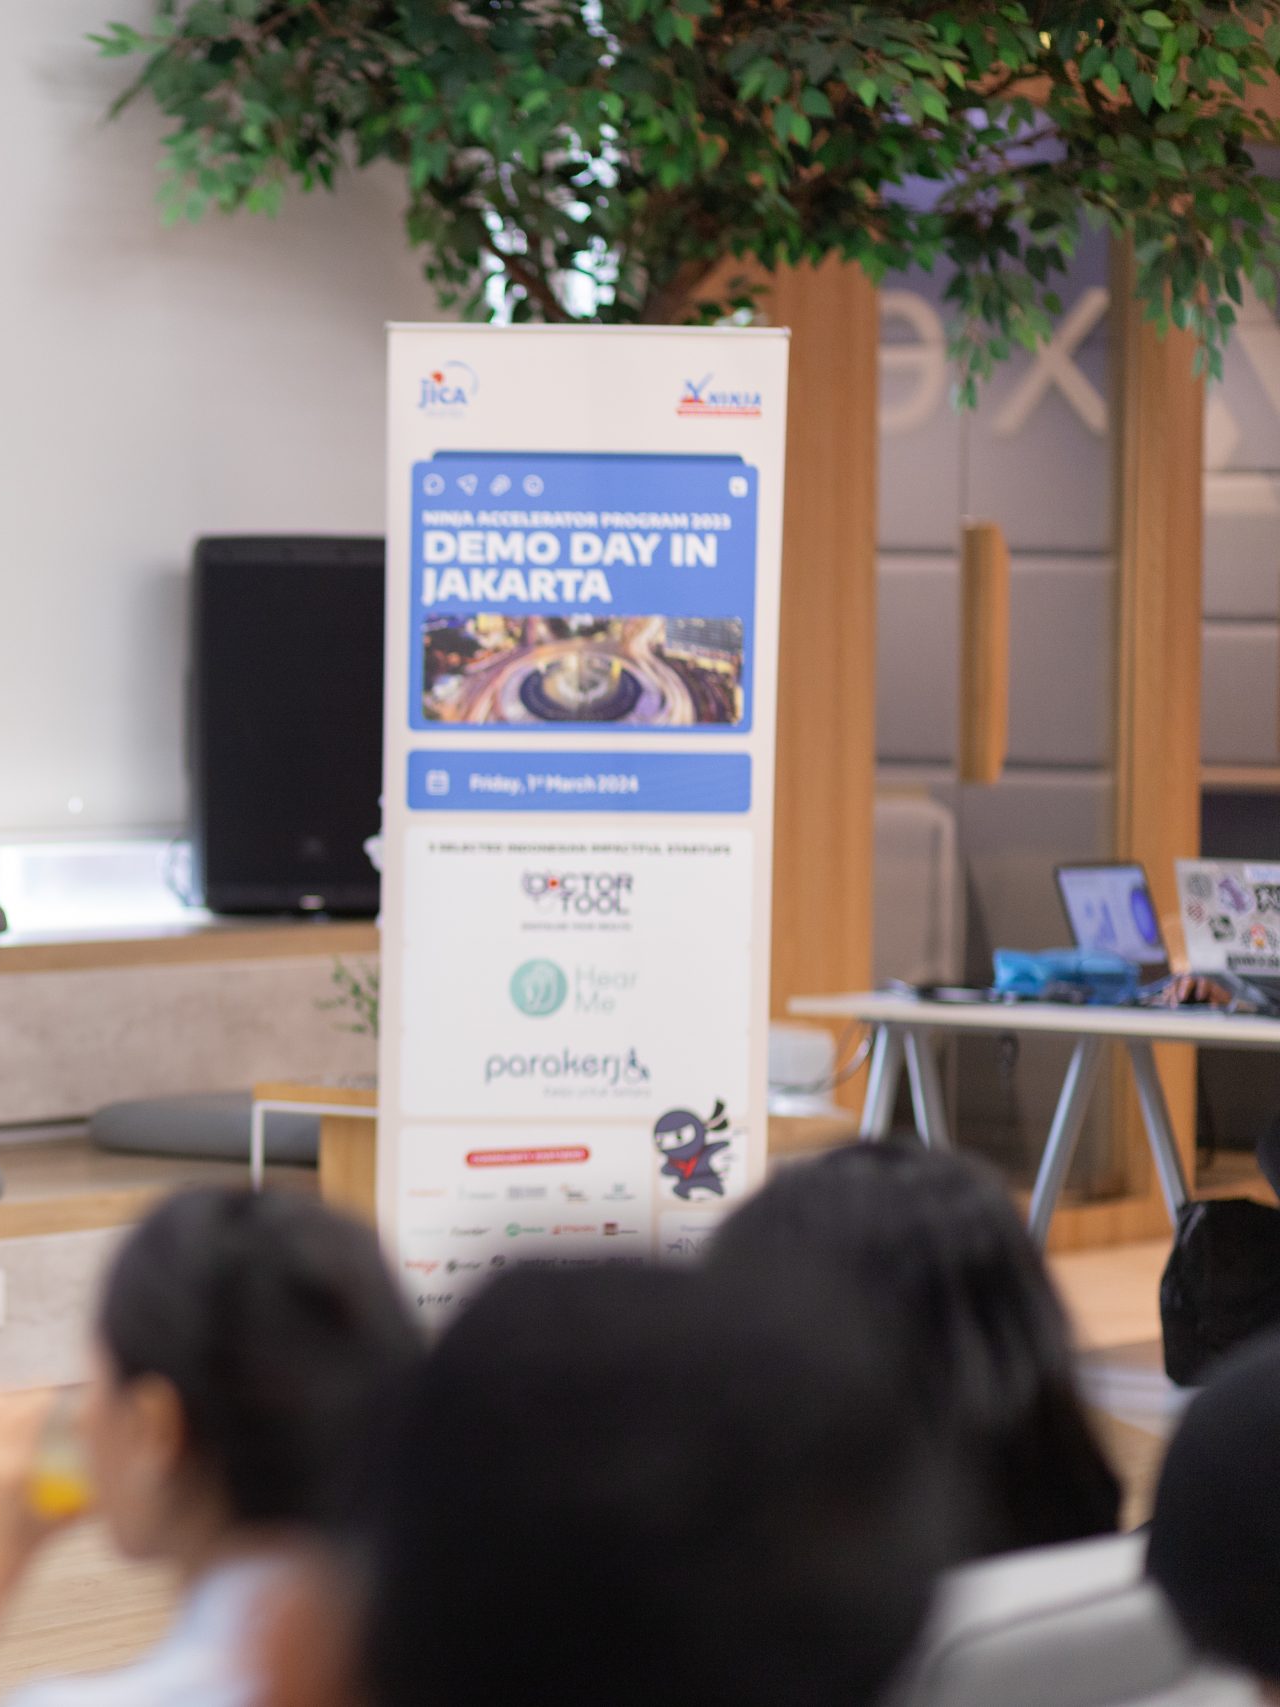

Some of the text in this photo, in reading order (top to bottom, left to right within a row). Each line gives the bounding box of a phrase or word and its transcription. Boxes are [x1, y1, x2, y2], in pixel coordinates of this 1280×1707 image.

[422, 510, 474, 528] NINJA
[476, 511, 598, 529] ACCELERATOR
[601, 512, 690, 530] PROGRAM
[423, 530, 718, 568] DEMO DAY IN
[422, 567, 613, 604] JAKARTA
[469, 773, 526, 796] Friday,
[546, 774, 596, 794] March
[597, 774, 639, 794] 2024
[560, 892, 630, 914] TOOL
[574, 965, 639, 991] Hear
[574, 993, 617, 1015] Me
